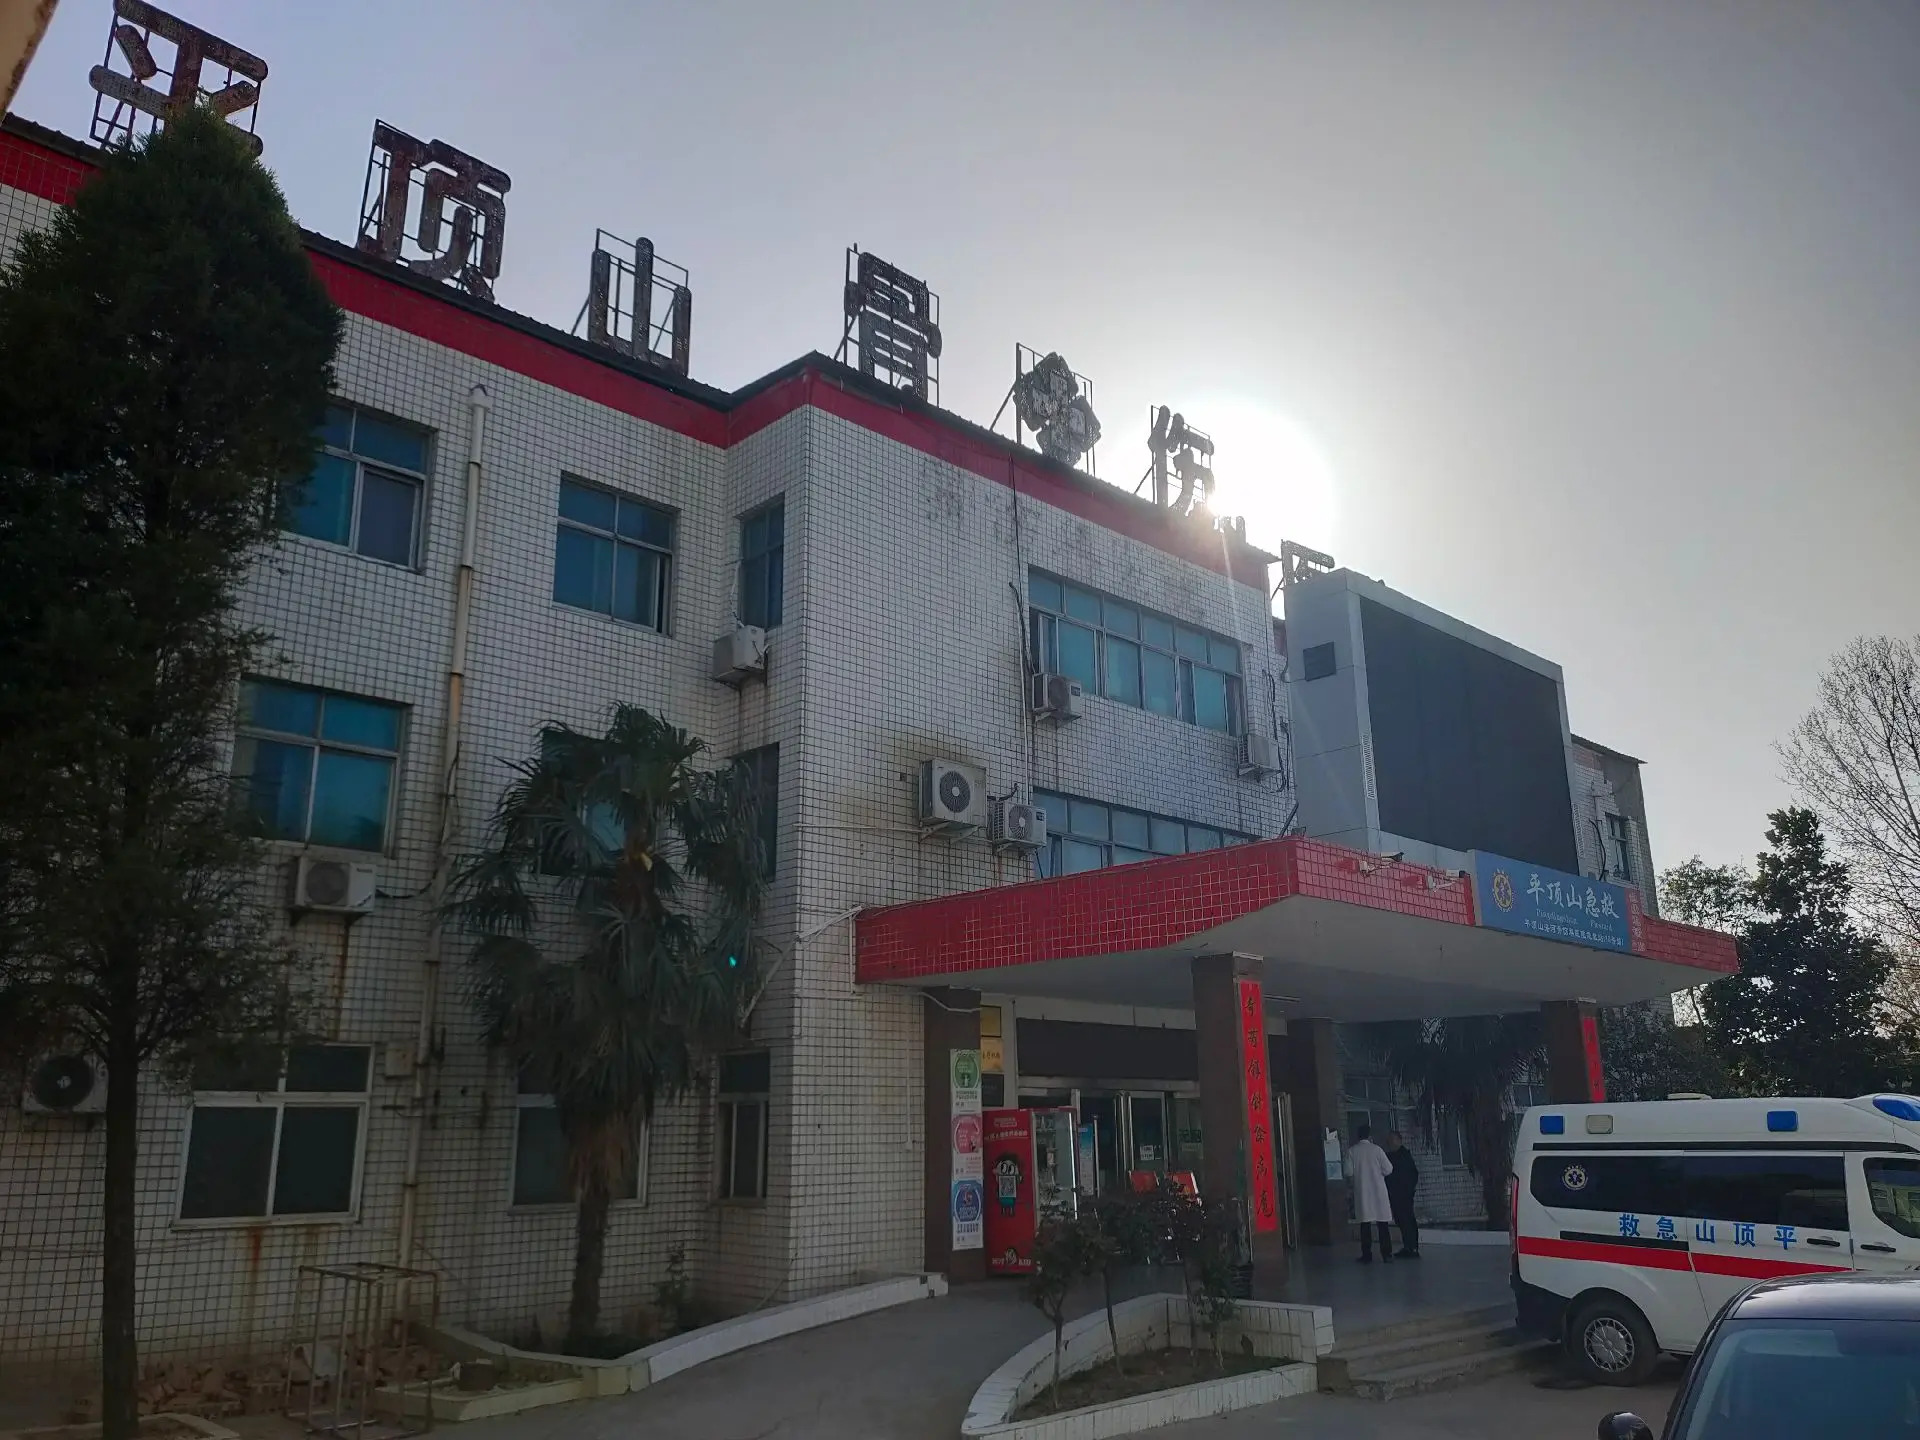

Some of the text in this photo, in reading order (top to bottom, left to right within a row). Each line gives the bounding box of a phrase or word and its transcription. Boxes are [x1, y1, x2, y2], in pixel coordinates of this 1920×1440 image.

[1527, 873, 1619, 919] 平顶山急救
